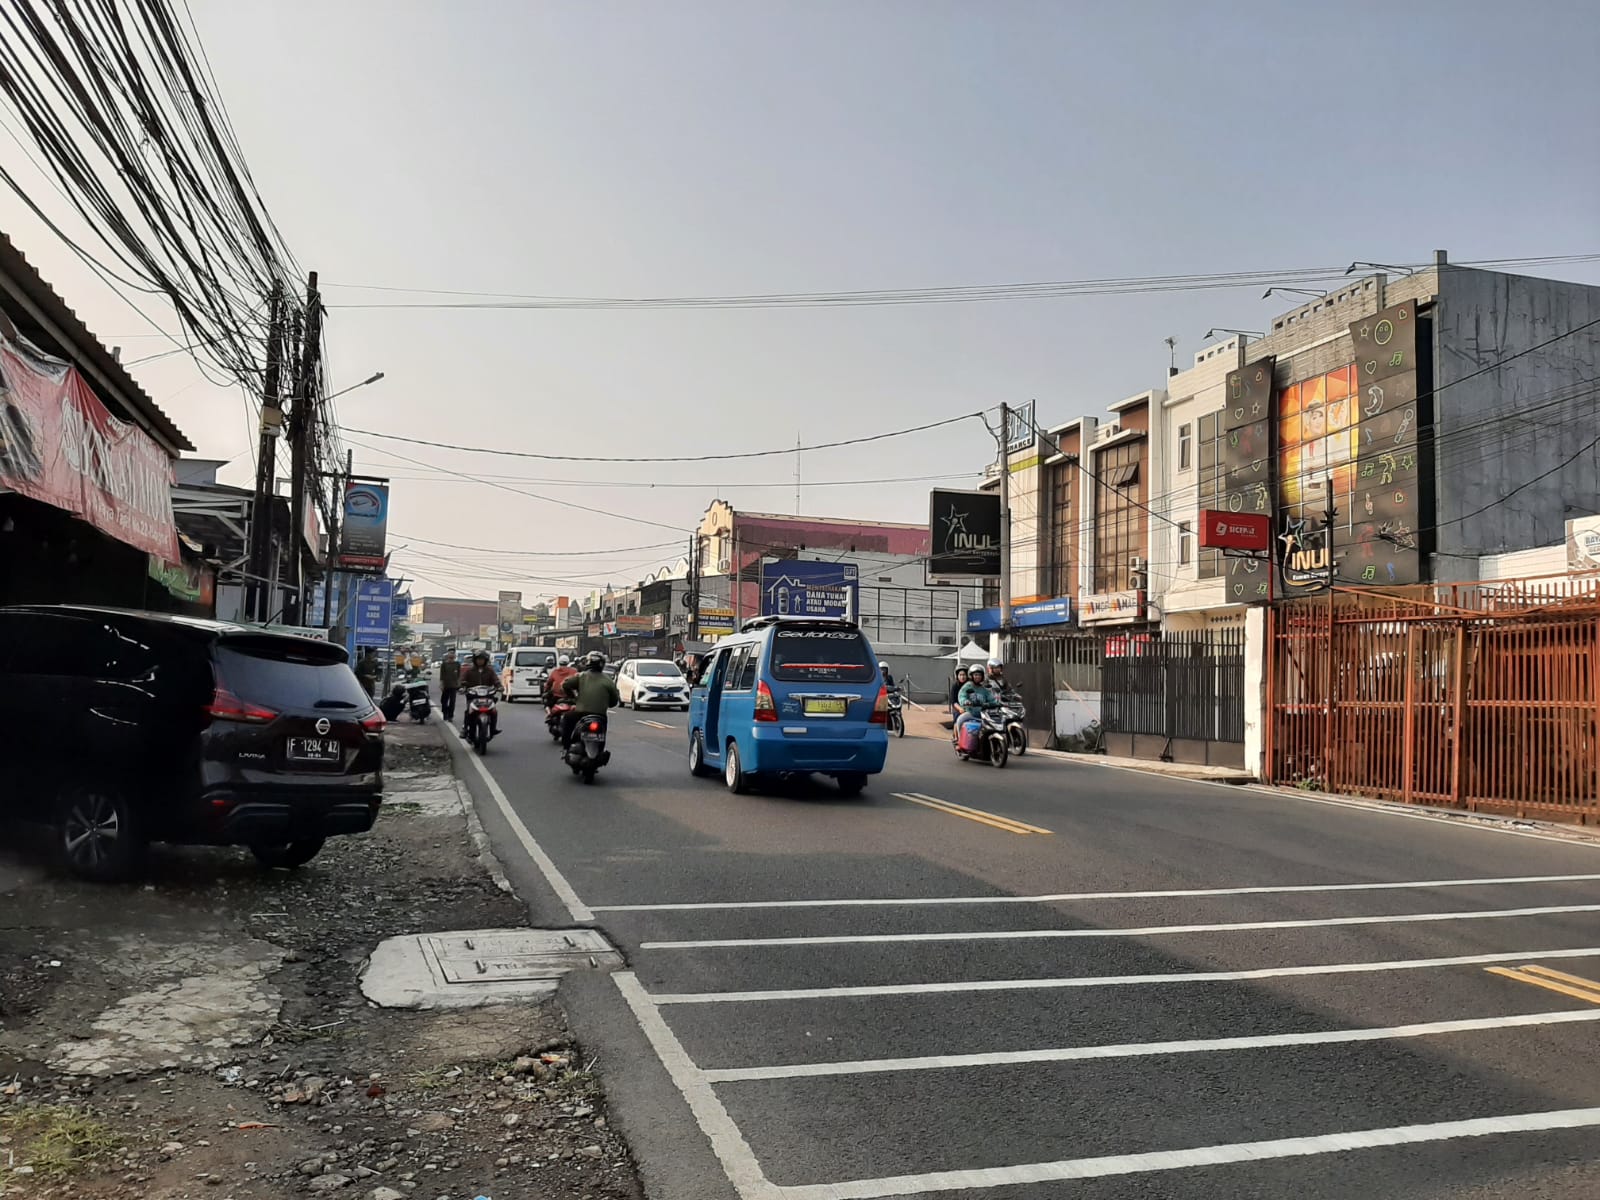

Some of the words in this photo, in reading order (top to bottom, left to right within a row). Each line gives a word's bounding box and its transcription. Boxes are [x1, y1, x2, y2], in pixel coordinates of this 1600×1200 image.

[806, 591, 826, 599] DANA
[827, 592, 846, 600] TUNAI
[290, 739, 296, 752] F
[303, 739, 322, 753] 1294
[327, 740, 338, 753] AZ
